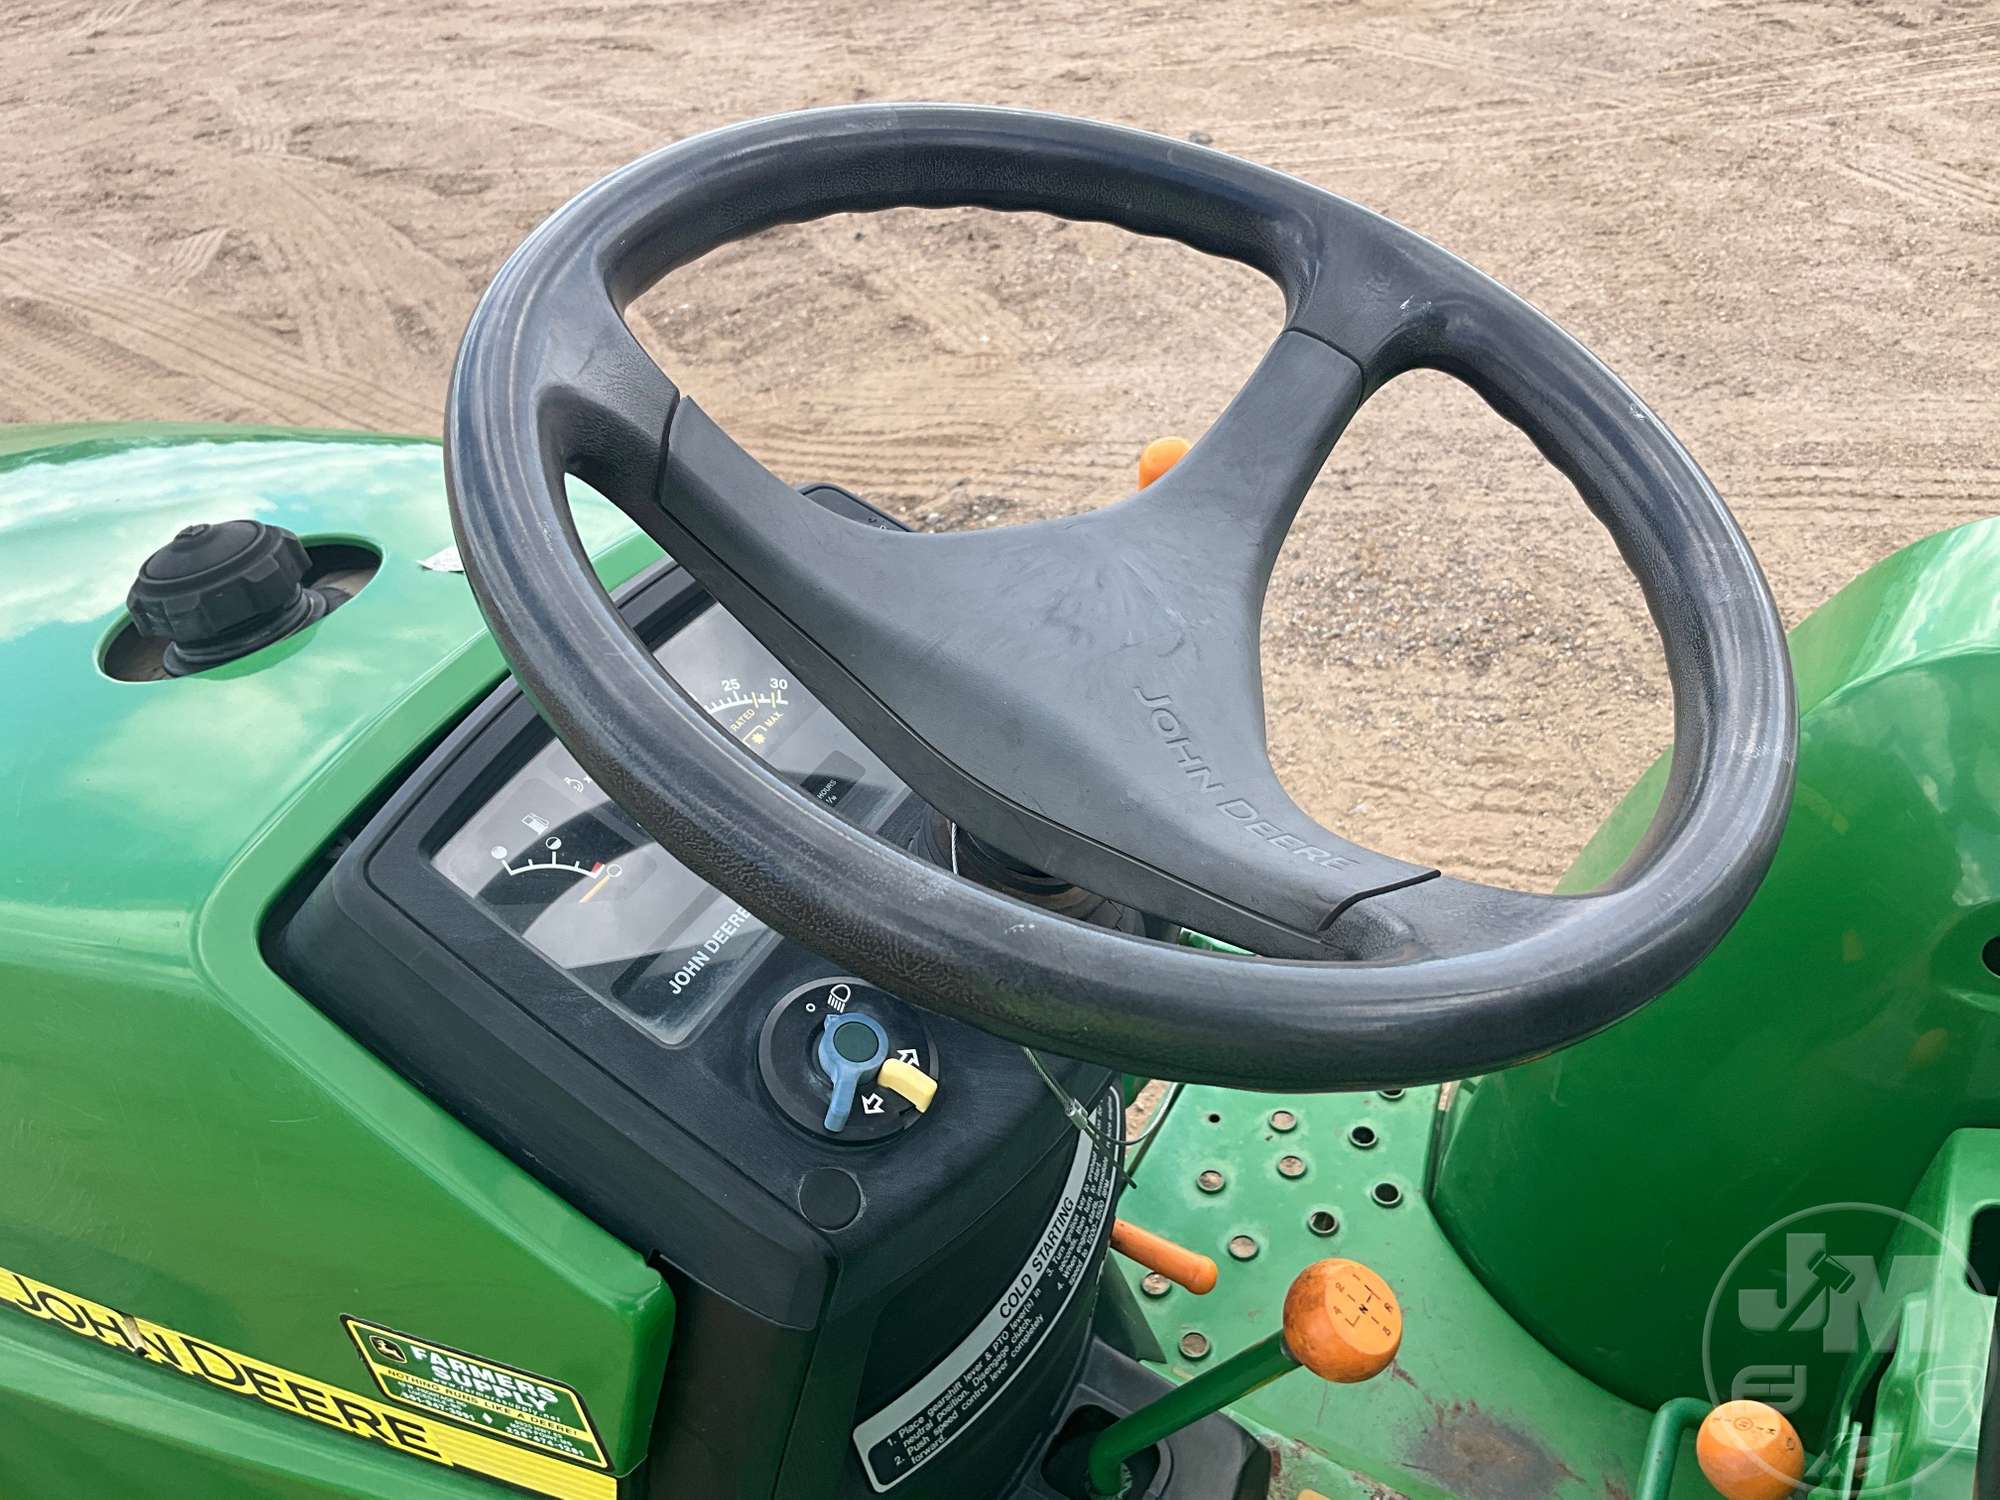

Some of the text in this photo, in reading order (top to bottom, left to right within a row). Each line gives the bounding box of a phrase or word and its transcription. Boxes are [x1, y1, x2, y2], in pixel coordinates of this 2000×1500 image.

[721, 678, 788, 691] 25 30
[730, 708, 755, 732] RATED
[764, 711, 784, 729] MAX
[817, 779, 837, 800] HOURS
[1134, 686, 1361, 873] JOHN DEERE
[668, 906, 751, 995] JOHN DEERE
[997, 1195, 1074, 1319] COLD STARTING
[1052, 1244, 1065, 1264] Turn
[1359, 1303, 1368, 1314] N
[10, 1275, 443, 1460] JOHN DEERE
[408, 1344, 560, 1404] FARMERS
[429, 1363, 552, 1413] SUPPLY
[886, 1286, 1041, 1447] 1. Place gearshift lever & PTO lever(s) in
[902, 1417, 933, 1449] neutral
[972, 1341, 1009, 1389] Disengage
[906, 1432, 929, 1457] Push
[932, 1409, 958, 1437] speed
[960, 1380, 988, 1410] control
[989, 1357, 1008, 1382] lever
[1009, 1312, 1045, 1358] completely
[386, 1368, 440, 1391] NOTHING
[443, 1387, 479, 1404] RUNS
[482, 1400, 510, 1414] LIKE
[515, 1411, 525, 1419] A
[528, 1415, 578, 1437] DEERE!
